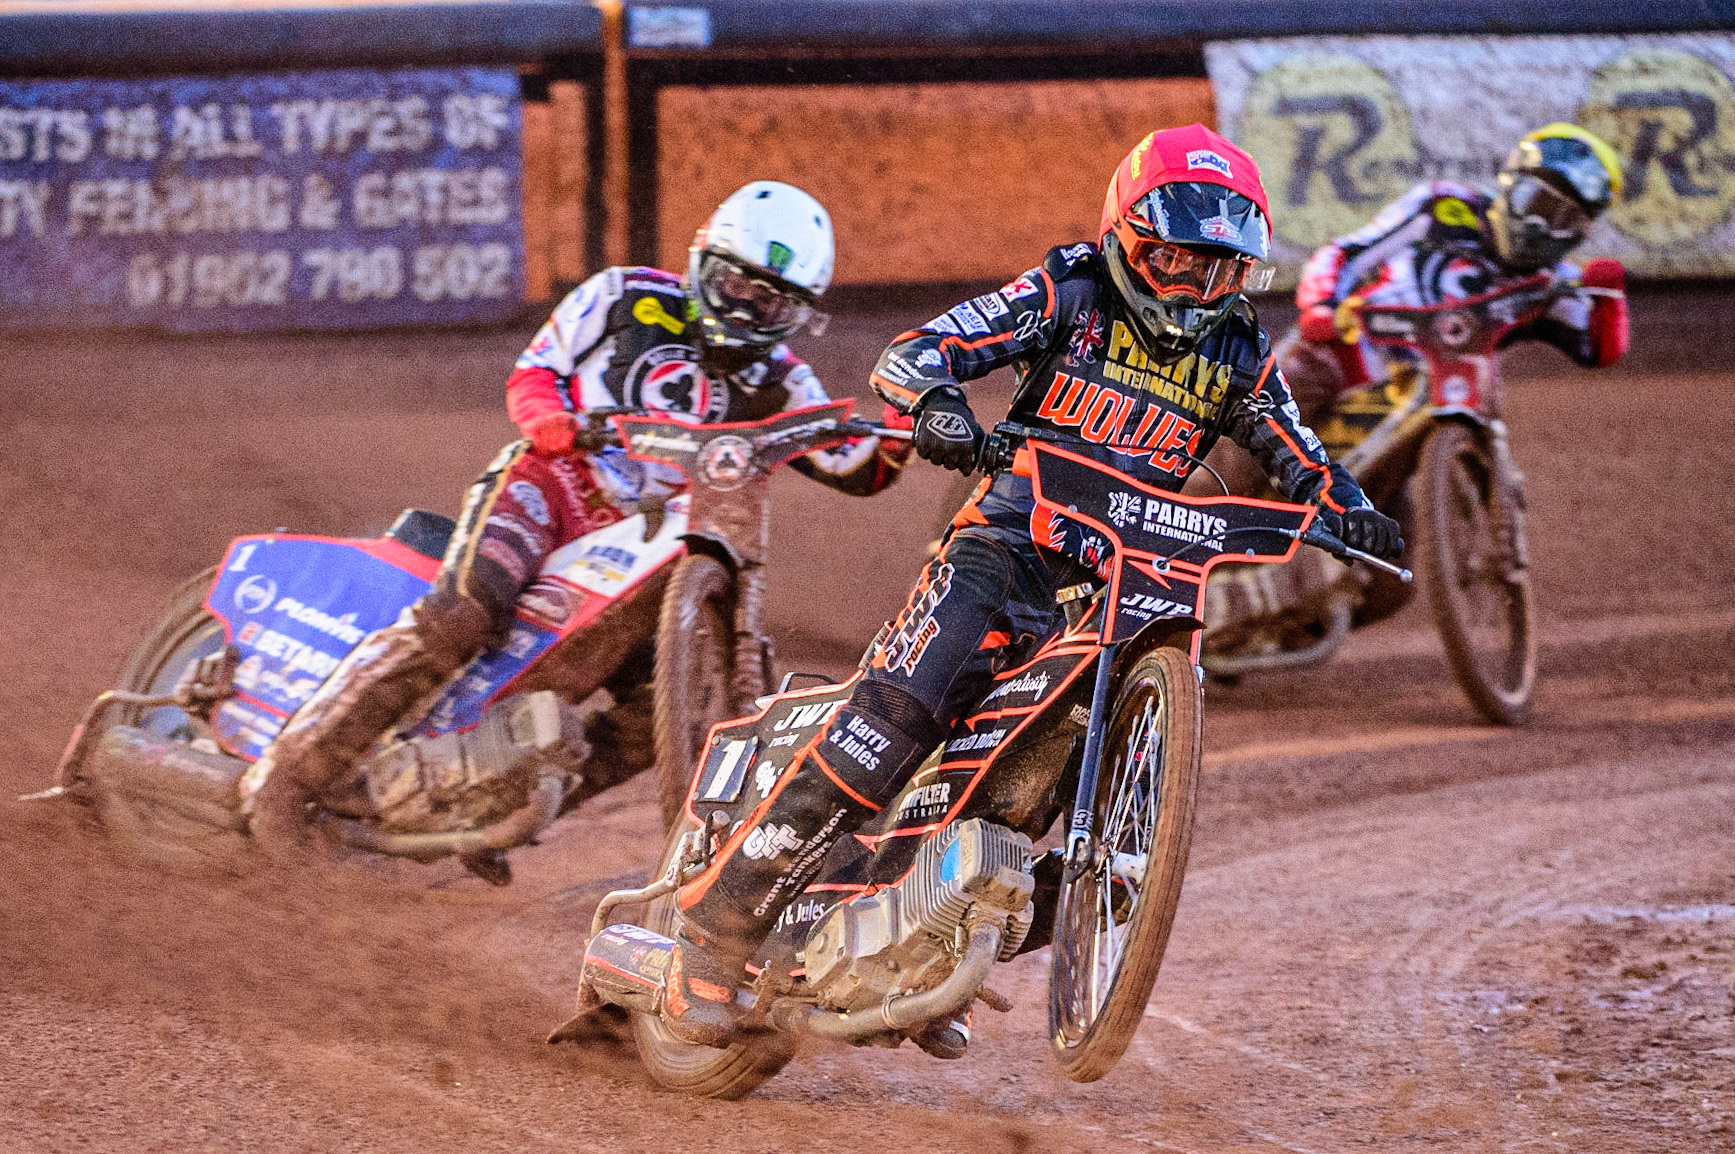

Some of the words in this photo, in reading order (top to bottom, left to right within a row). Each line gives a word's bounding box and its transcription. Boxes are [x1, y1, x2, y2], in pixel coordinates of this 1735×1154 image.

[170, 102, 262, 158] ALL
[271, 97, 430, 153] TYPES
[354, 167, 510, 229] GATES
[411, 243, 511, 301] 502
[1036, 371, 1205, 478] WOLVES
[1144, 498, 1227, 540] PARRYS
[228, 544, 257, 572] 1
[1120, 593, 1194, 616] JWP
[1120, 607, 1152, 621] racing
[901, 616, 941, 678] racing
[828, 729, 842, 745] &
[839, 735, 881, 772] Jules
[846, 714, 892, 753] Harry
[704, 740, 747, 799] 1
[753, 876, 787, 917] Grant
[783, 808, 848, 873] Henderson
[785, 840, 833, 887] Tankers
[795, 899, 826, 924] Jules
